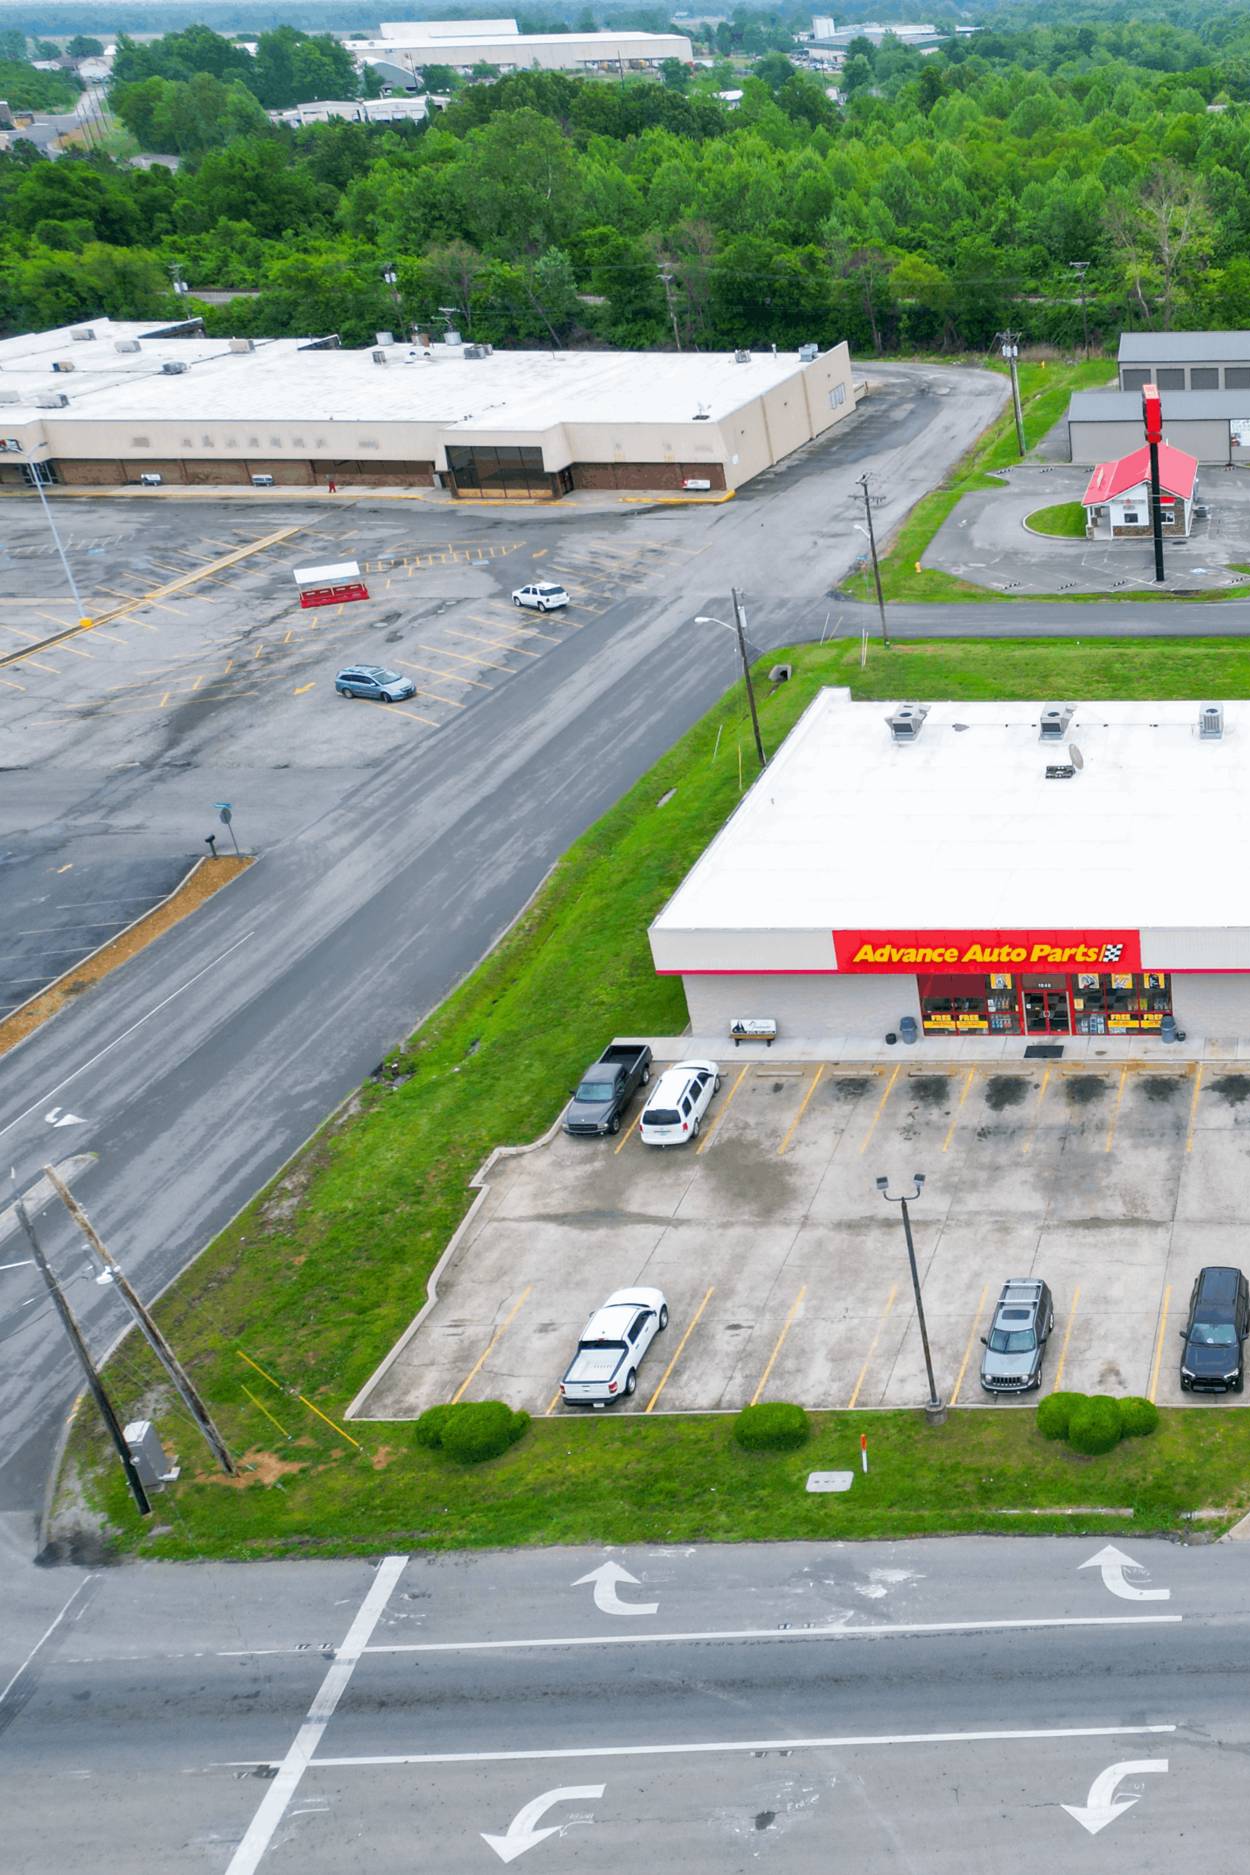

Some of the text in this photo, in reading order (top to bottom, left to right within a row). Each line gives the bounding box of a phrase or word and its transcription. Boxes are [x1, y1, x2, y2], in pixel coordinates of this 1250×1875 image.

[853, 944, 1098, 963] Advance Auto Parts
